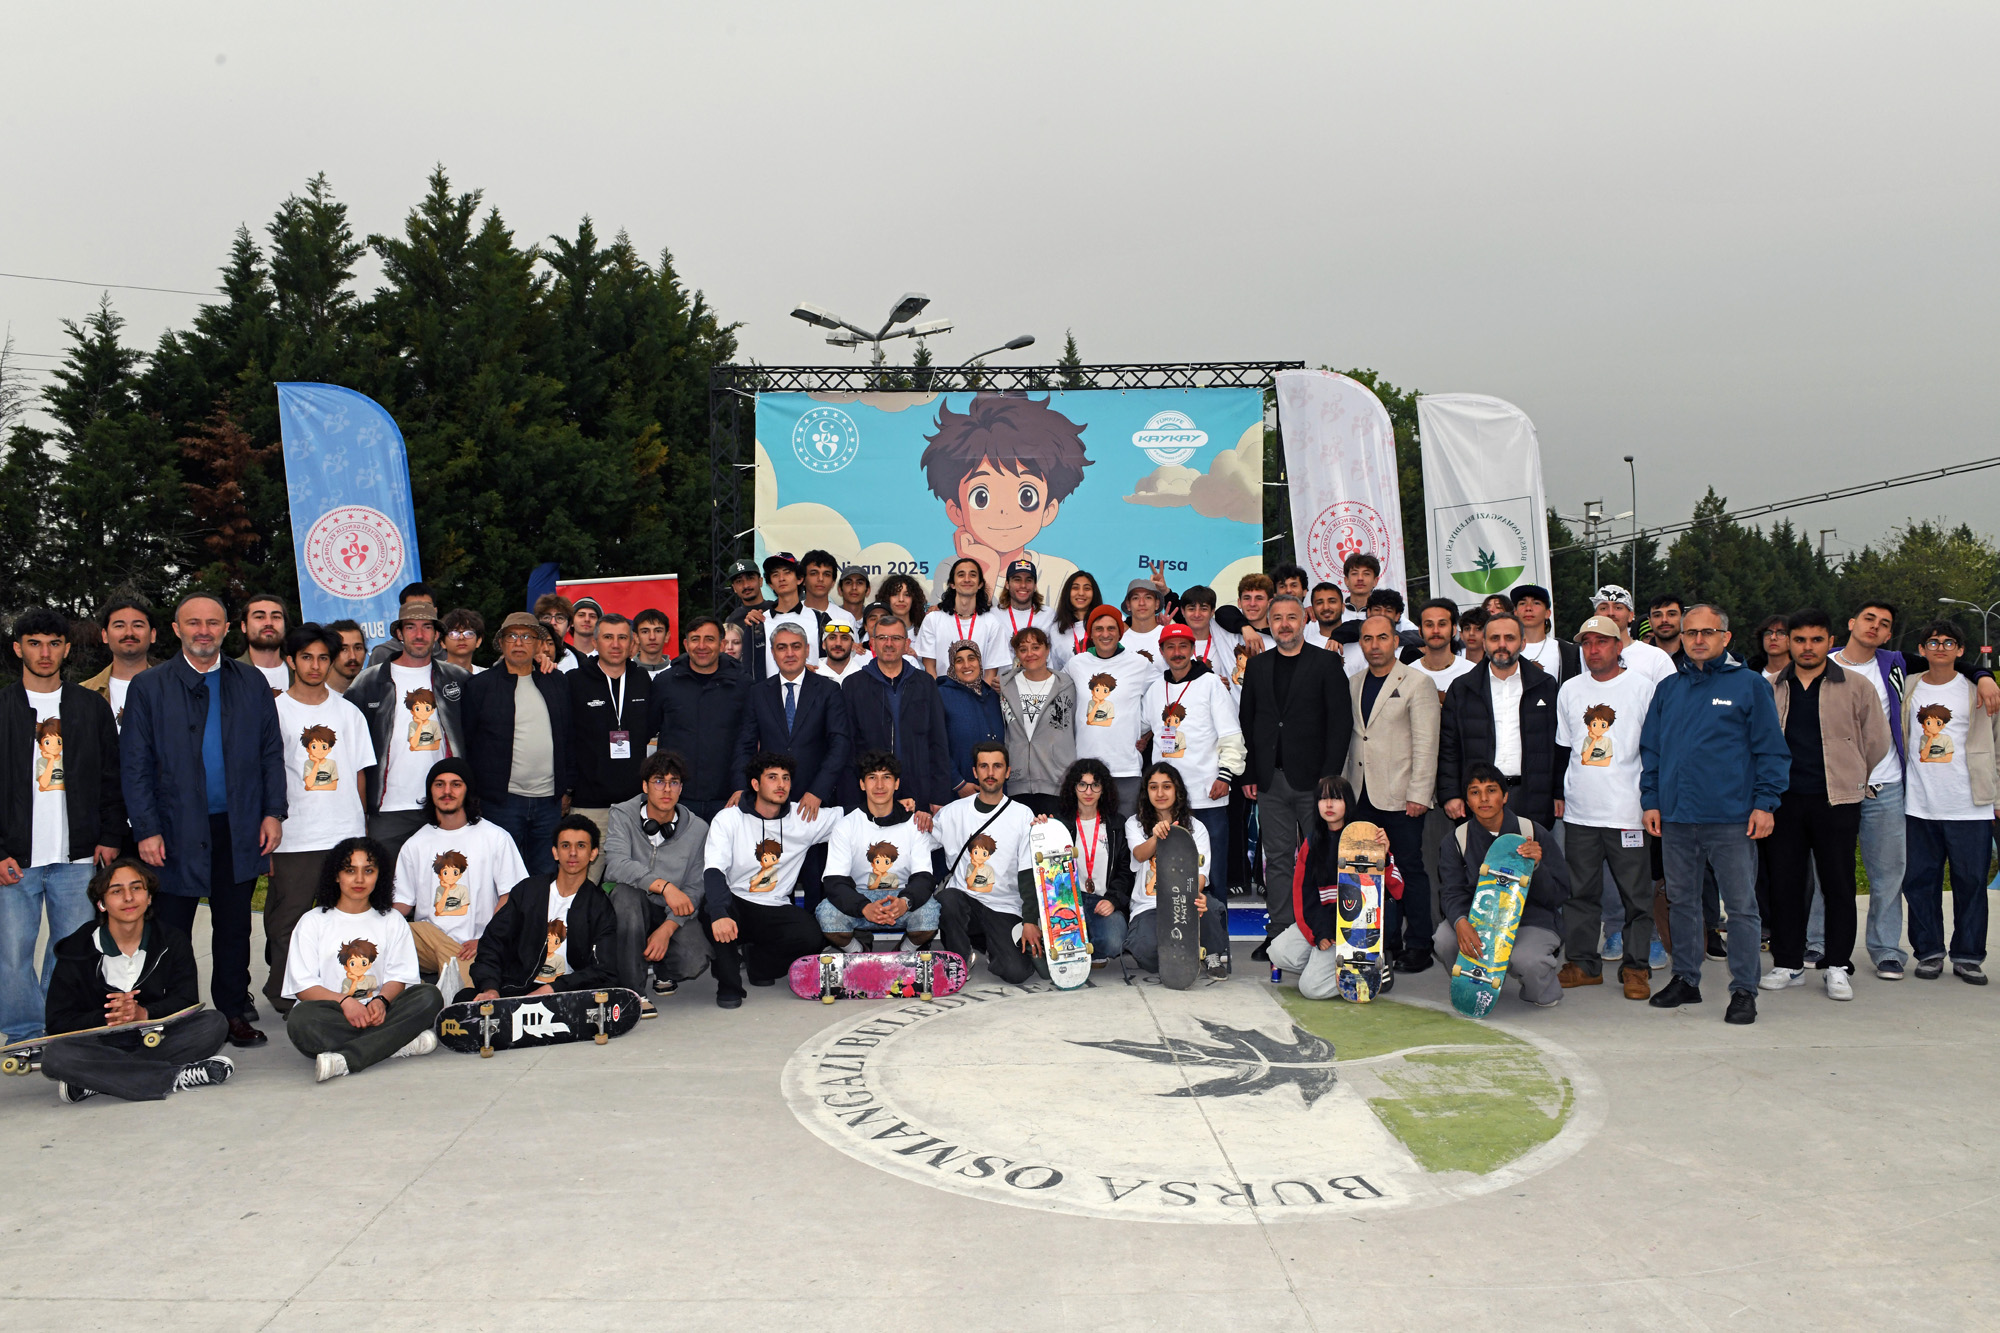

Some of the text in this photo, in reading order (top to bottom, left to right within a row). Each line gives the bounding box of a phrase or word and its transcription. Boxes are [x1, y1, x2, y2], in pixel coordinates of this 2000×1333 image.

[1138, 435, 1202, 443] KAYKAY
[887, 561, 929, 575] 2025
[1139, 555, 1188, 571] Bursa
[1172, 886, 1181, 924] WORLD
[1096, 1175, 1389, 1206] BURSA
